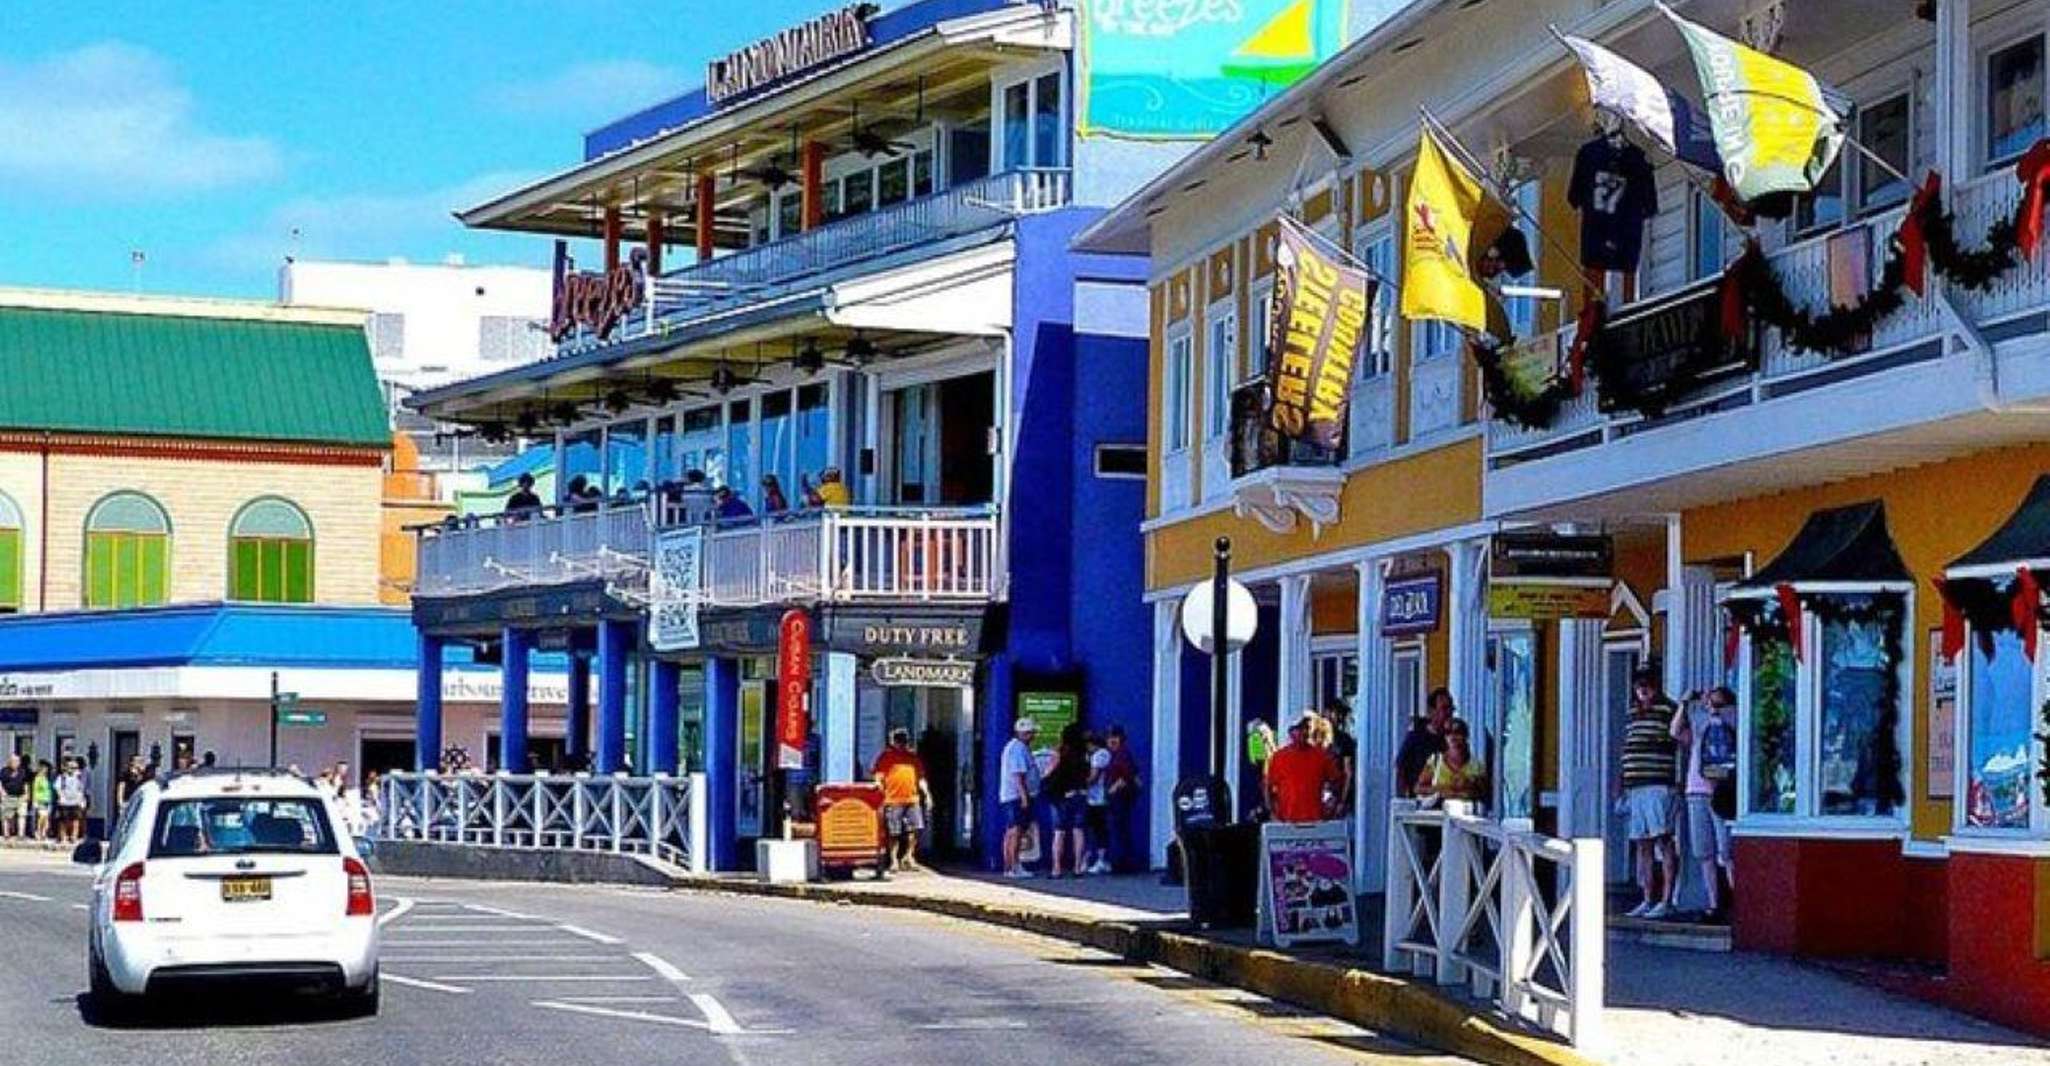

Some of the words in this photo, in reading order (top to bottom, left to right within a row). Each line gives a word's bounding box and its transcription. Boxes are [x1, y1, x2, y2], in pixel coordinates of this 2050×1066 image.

[864, 626, 916, 645] DUTY
[920, 626, 969, 646] FREE
[884, 664, 972, 682] LANDMARK
